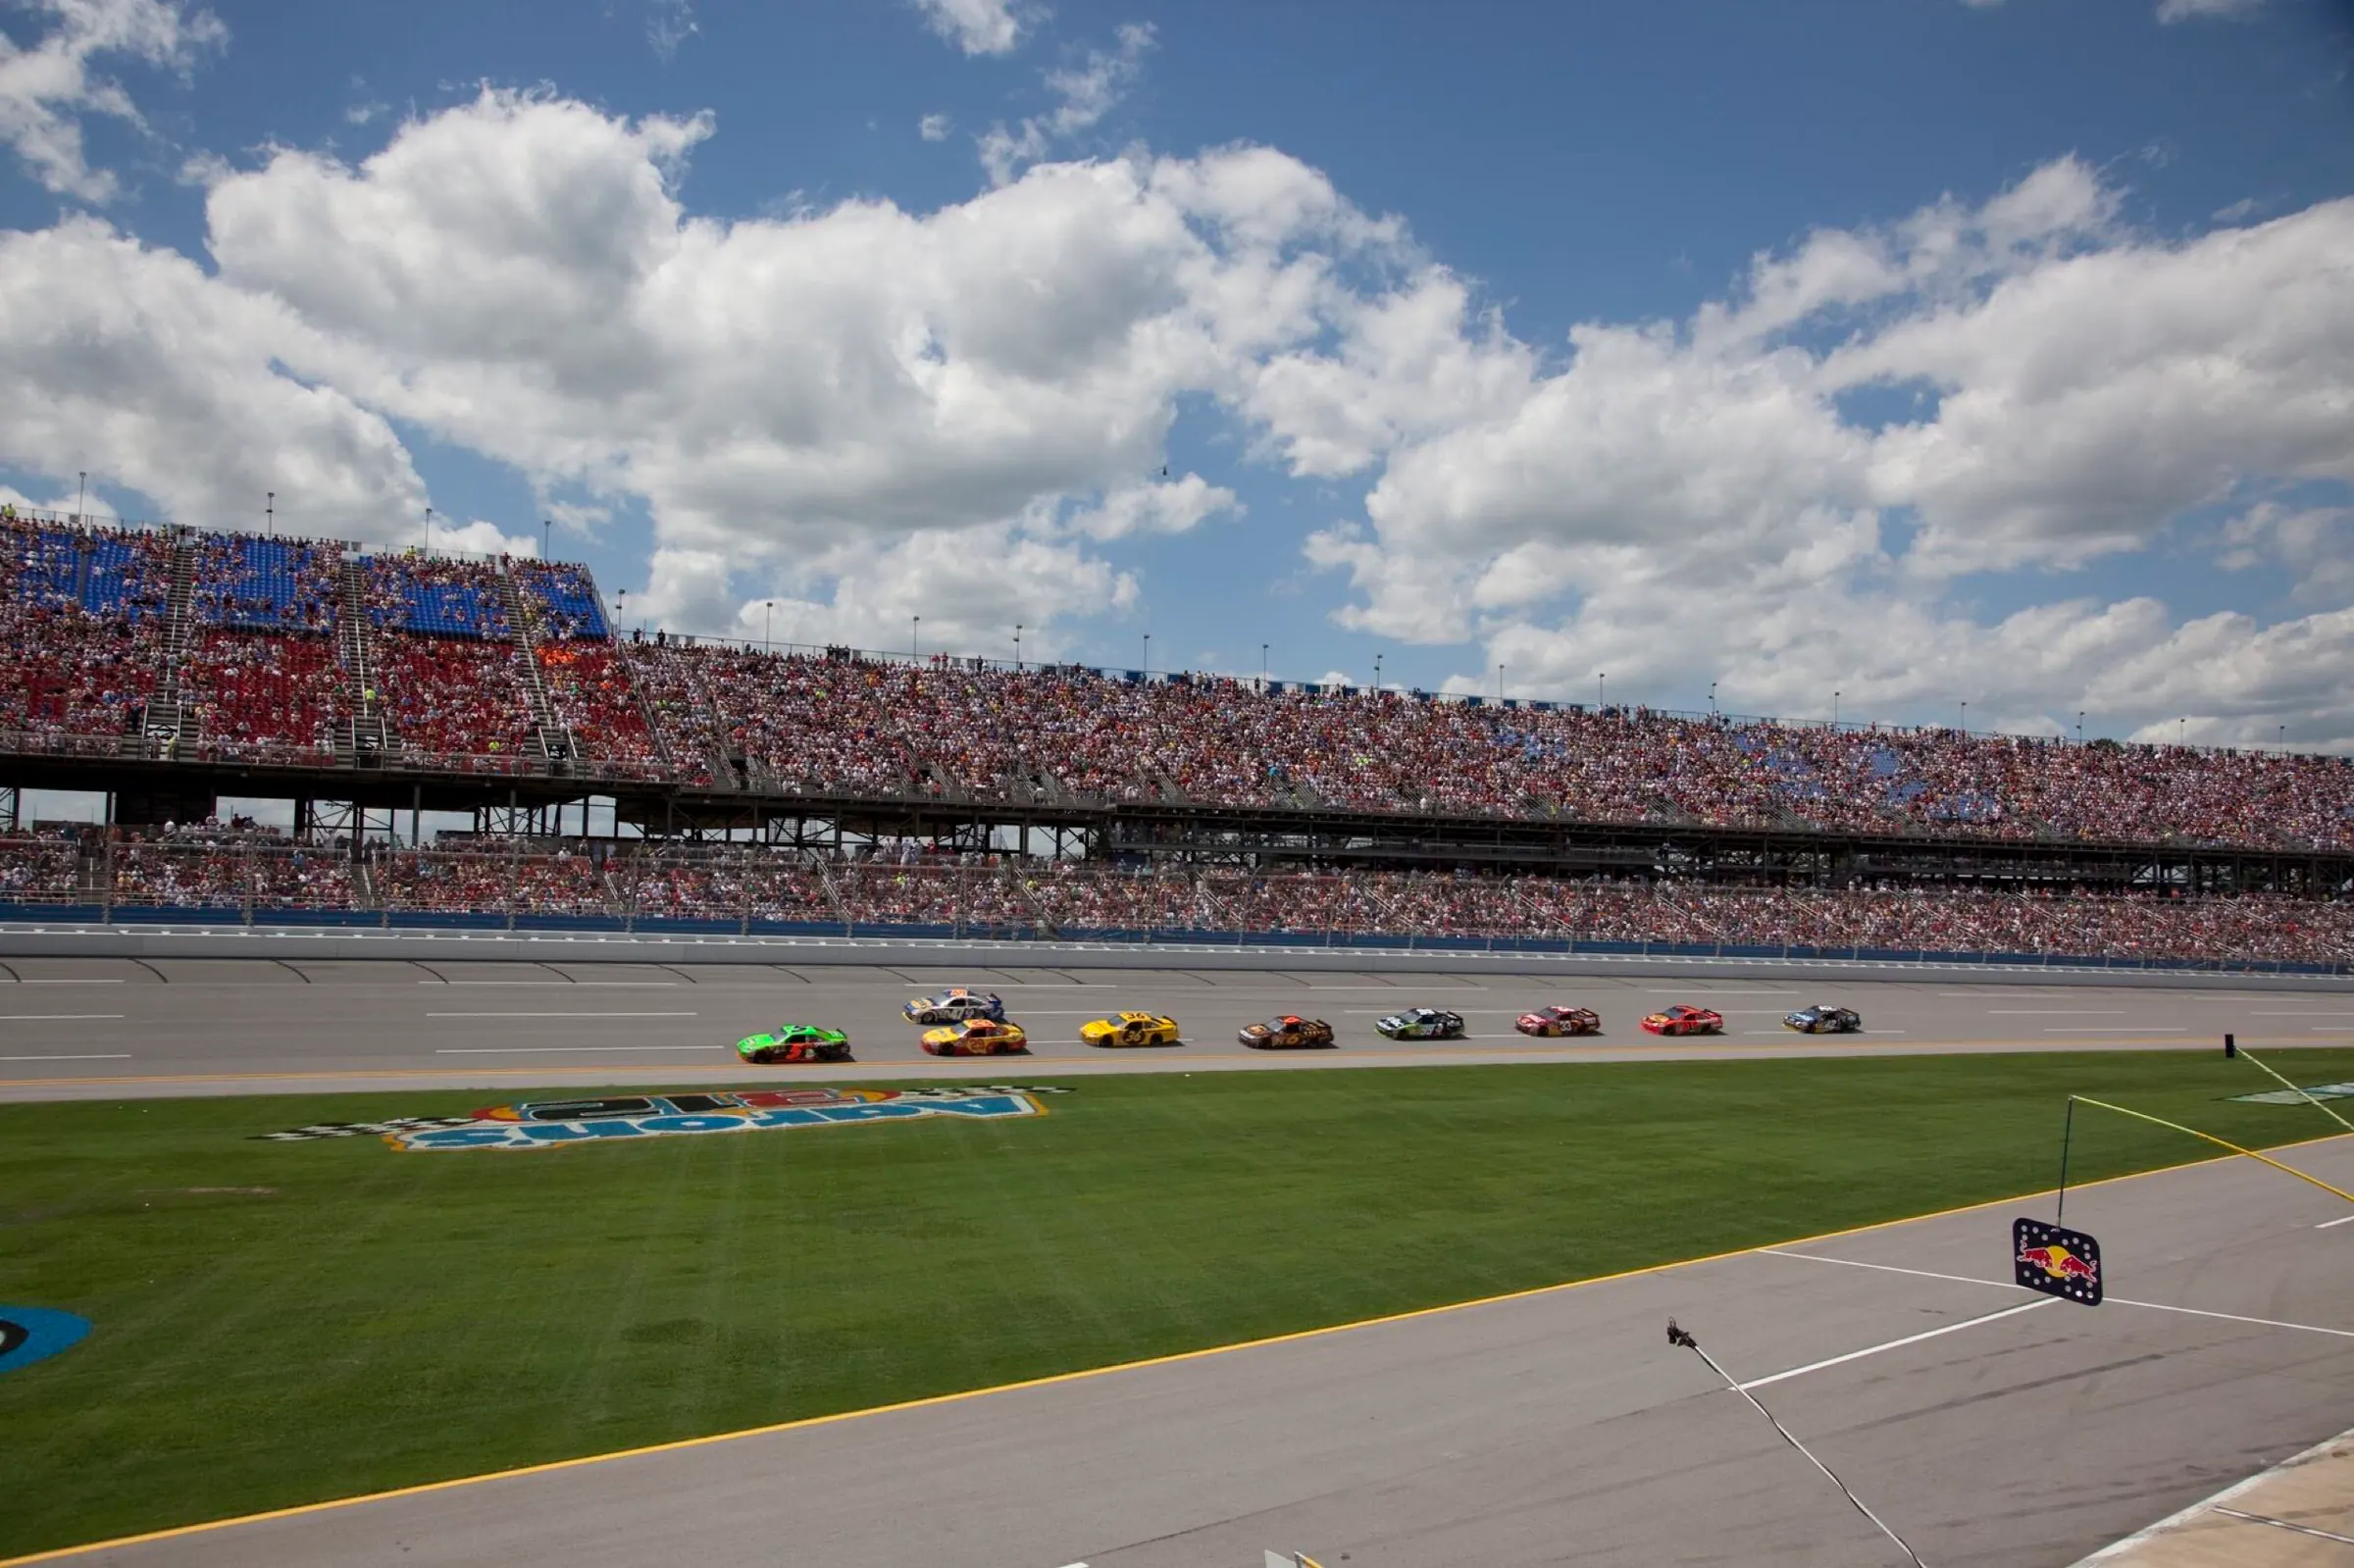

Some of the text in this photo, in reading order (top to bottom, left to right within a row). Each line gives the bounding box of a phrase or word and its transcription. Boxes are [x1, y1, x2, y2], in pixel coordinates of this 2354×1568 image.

[1560, 1021, 1572, 1032] 33
[1124, 1031, 1142, 1041] 36
[401, 1094, 1035, 1147] Aaron's
